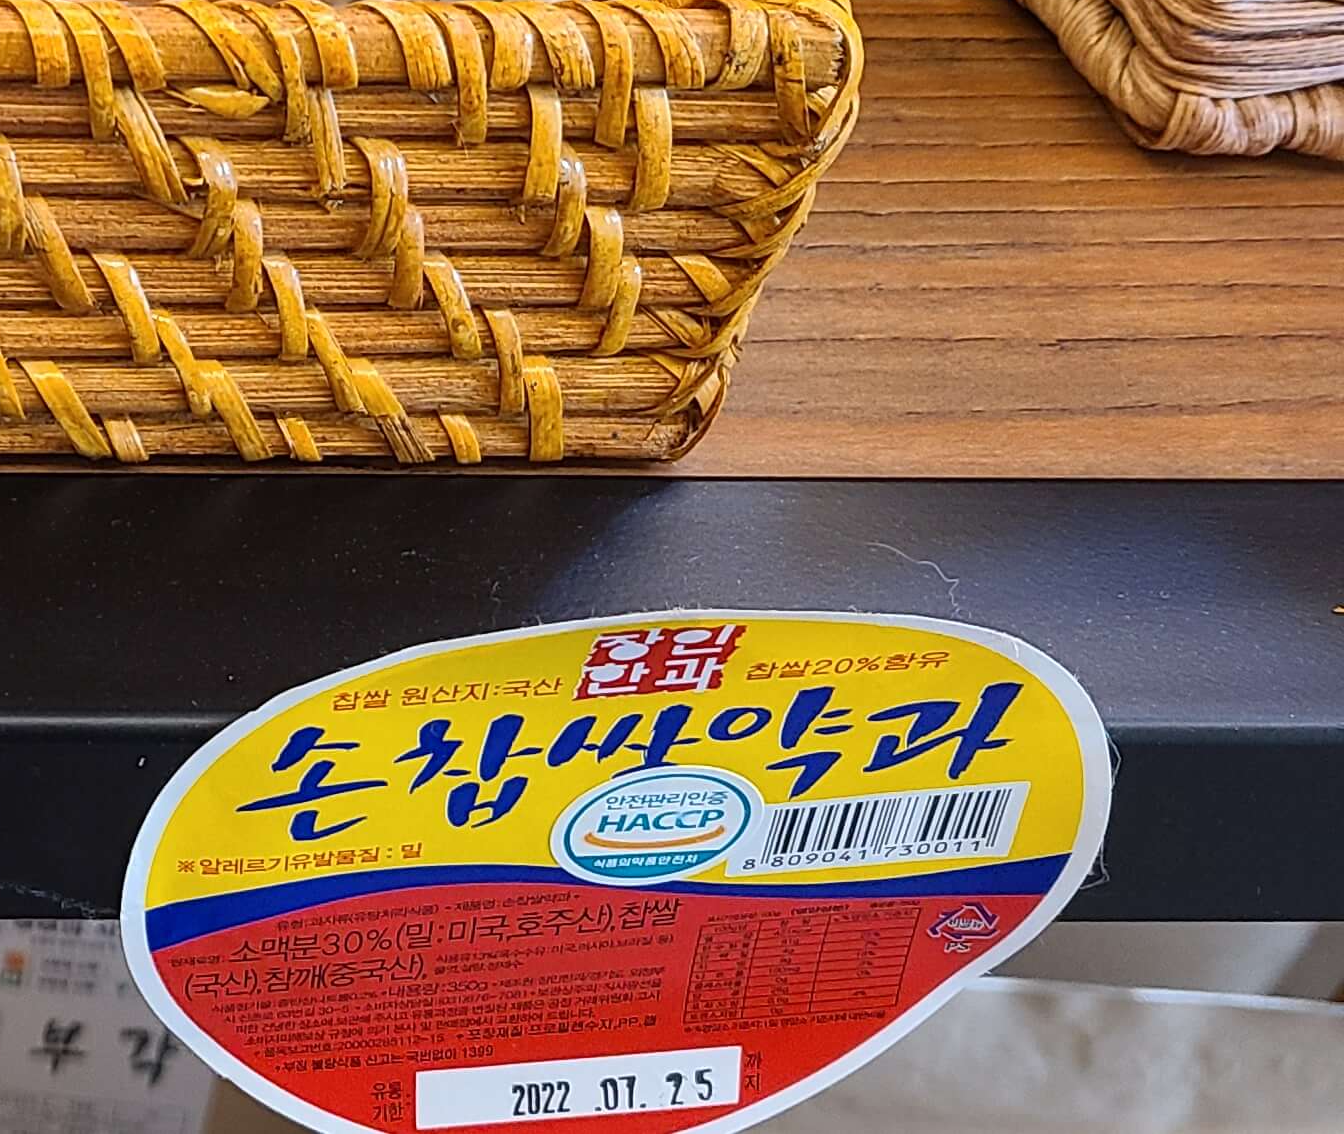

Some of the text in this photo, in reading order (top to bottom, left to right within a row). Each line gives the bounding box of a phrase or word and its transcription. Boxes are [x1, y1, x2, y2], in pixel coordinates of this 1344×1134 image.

[597, 624, 736, 661] 장인
[584, 657, 724, 693] 한과
[747, 650, 950, 681] 찹쌀20%함유
[332, 687, 392, 710] 찹쌀
[606, 791, 729, 810] 안전관리인증
[597, 809, 725, 833] HACCP
[401, 842, 422, 861] 밀
[742, 840, 982, 870] 8 809041 730011
[512, 1080, 572, 1118] 2022
